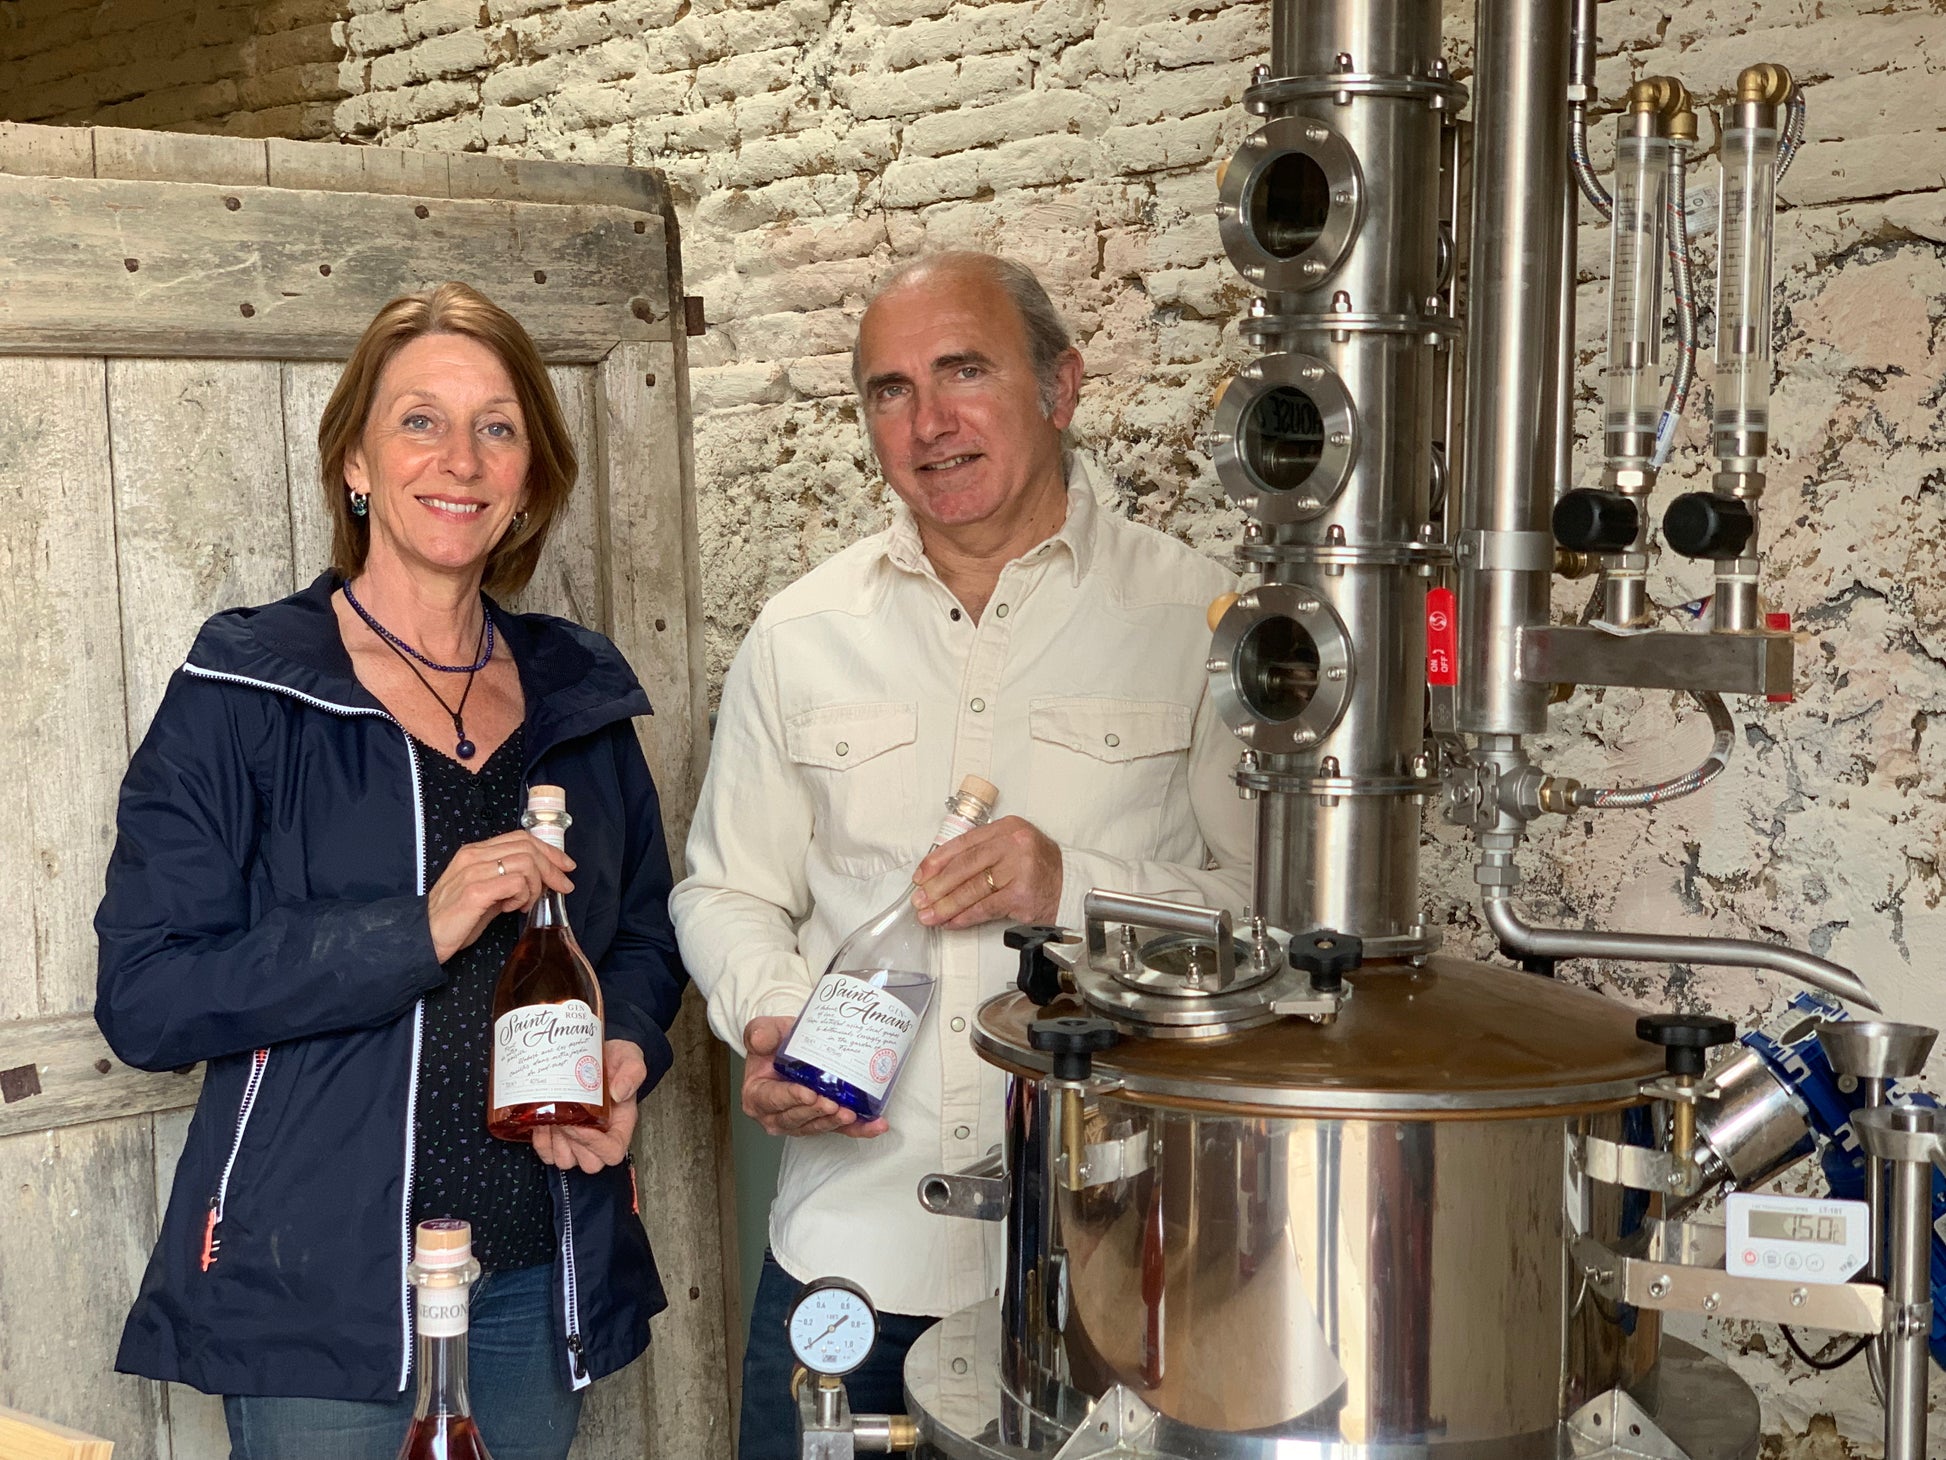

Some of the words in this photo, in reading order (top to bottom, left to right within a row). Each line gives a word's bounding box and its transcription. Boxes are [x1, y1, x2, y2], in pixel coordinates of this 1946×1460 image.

[1430, 659, 1438, 672] ON
[820, 978, 878, 1003] Saint
[839, 1001, 913, 1033] Amans
[888, 1004, 904, 1018] GIN
[500, 1010, 552, 1046] Saint
[523, 1017, 597, 1047] Amans
